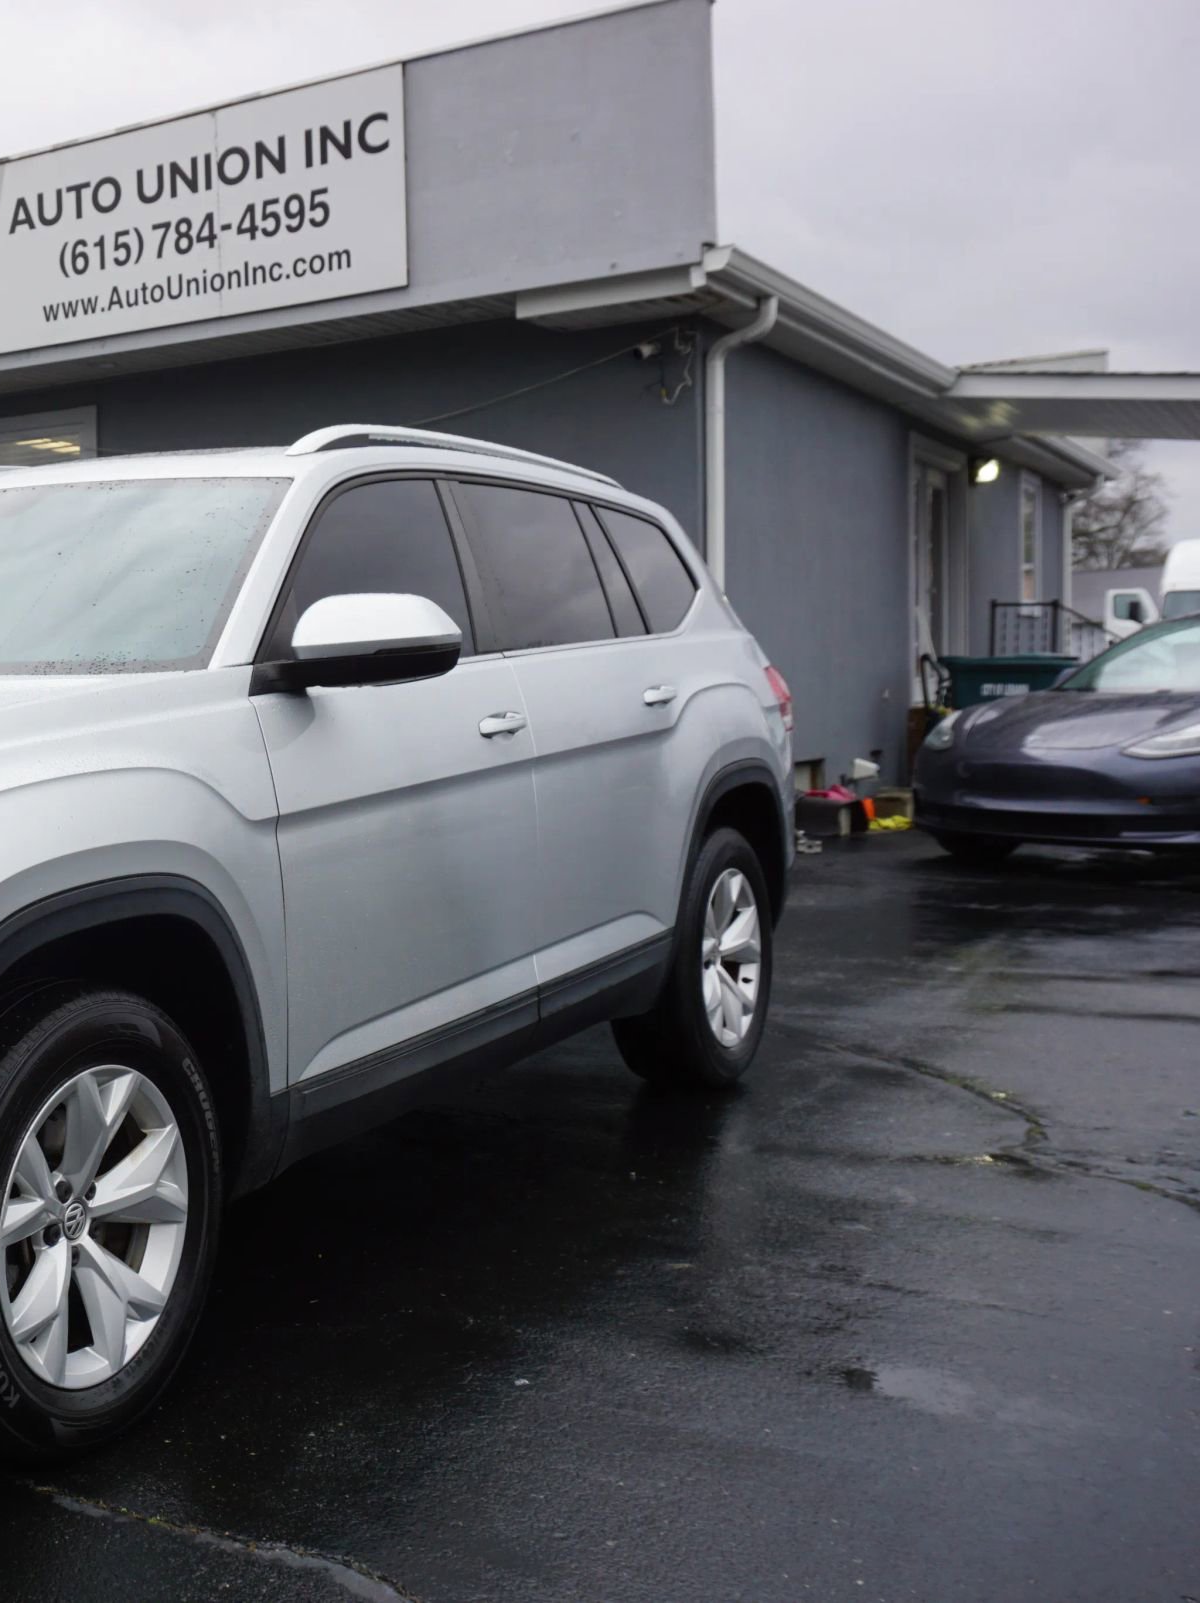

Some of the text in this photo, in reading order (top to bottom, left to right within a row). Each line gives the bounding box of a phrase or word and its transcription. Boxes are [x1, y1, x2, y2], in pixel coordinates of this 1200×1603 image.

[8, 112, 390, 234] AUTO UNION INC
[58, 187, 331, 278] (615) 784-4595
[43, 249, 352, 322] www.AutoUnionInc.com
